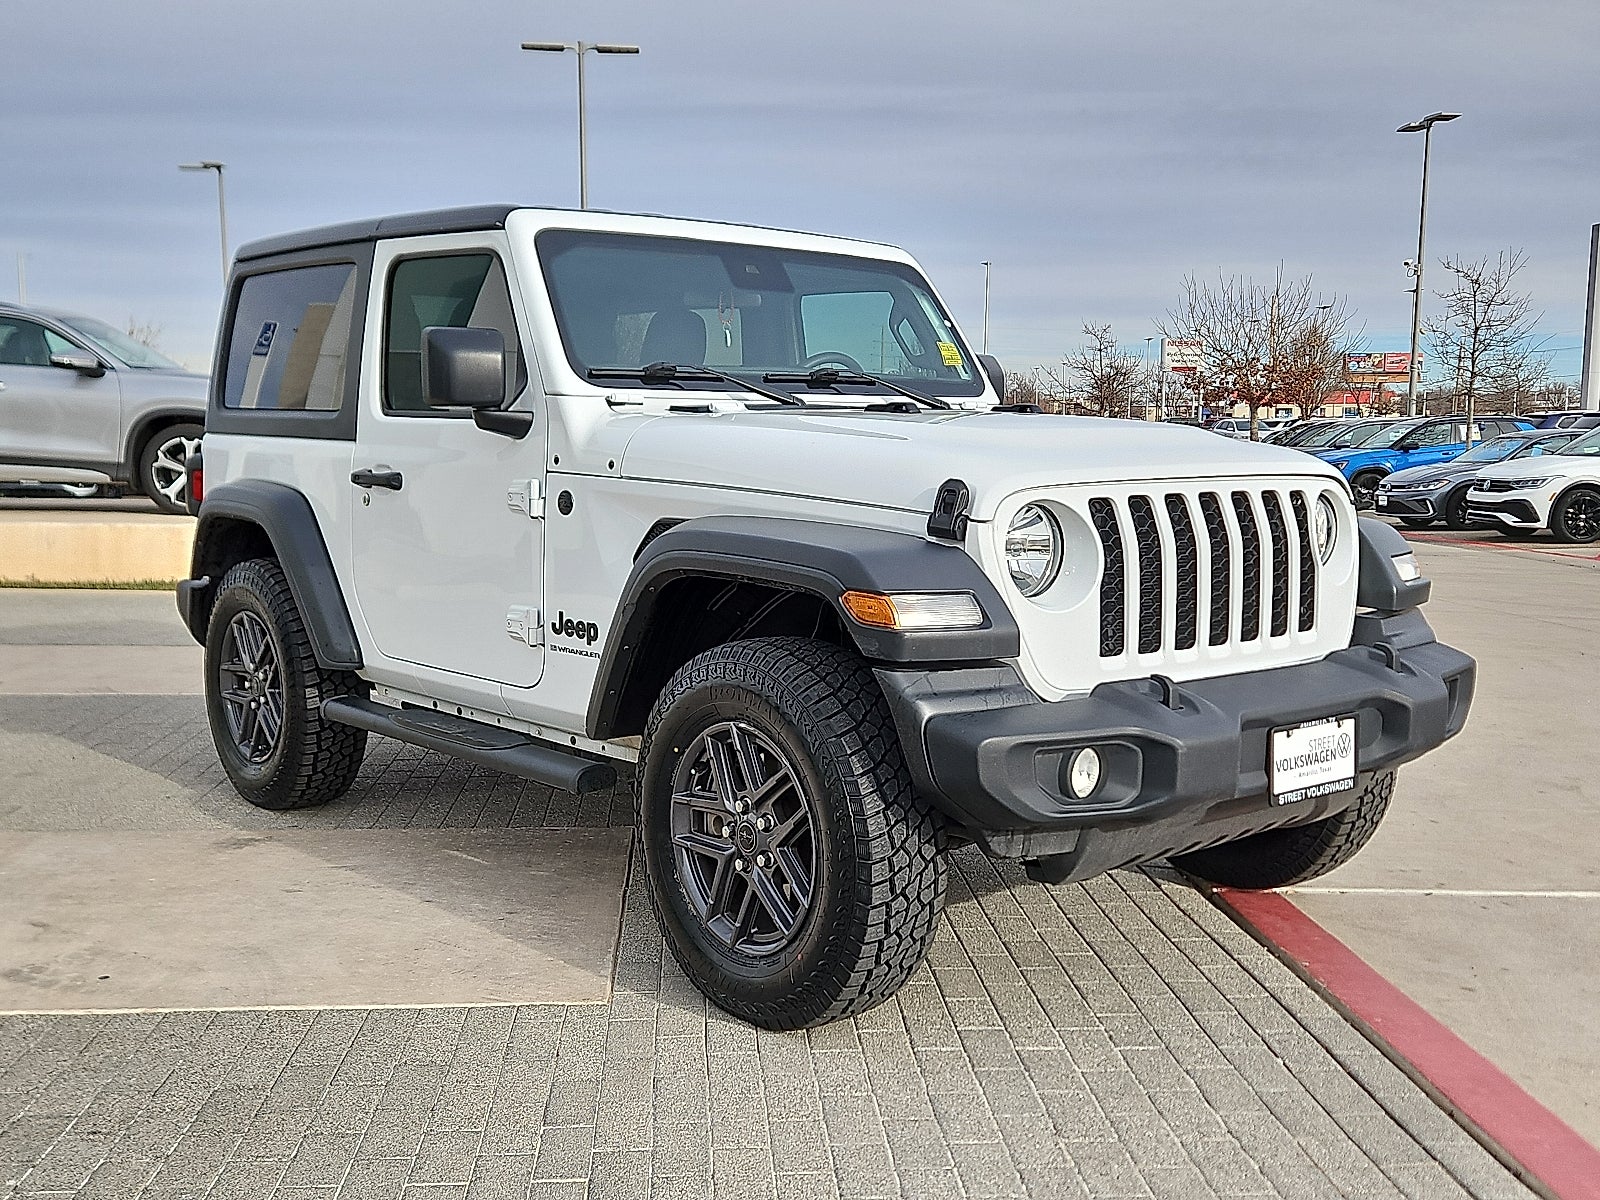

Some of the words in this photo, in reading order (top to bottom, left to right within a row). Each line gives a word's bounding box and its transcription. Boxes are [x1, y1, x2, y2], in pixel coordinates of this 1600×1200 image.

[551, 610, 599, 646] Jeep
[557, 645, 601, 659] WRANGLER
[1308, 735, 1336, 752] STREET
[1275, 747, 1337, 772] VOLKSWAGEN
[1278, 789, 1307, 806] STREET
[1306, 779, 1354, 798] VOLKSWAGEN
